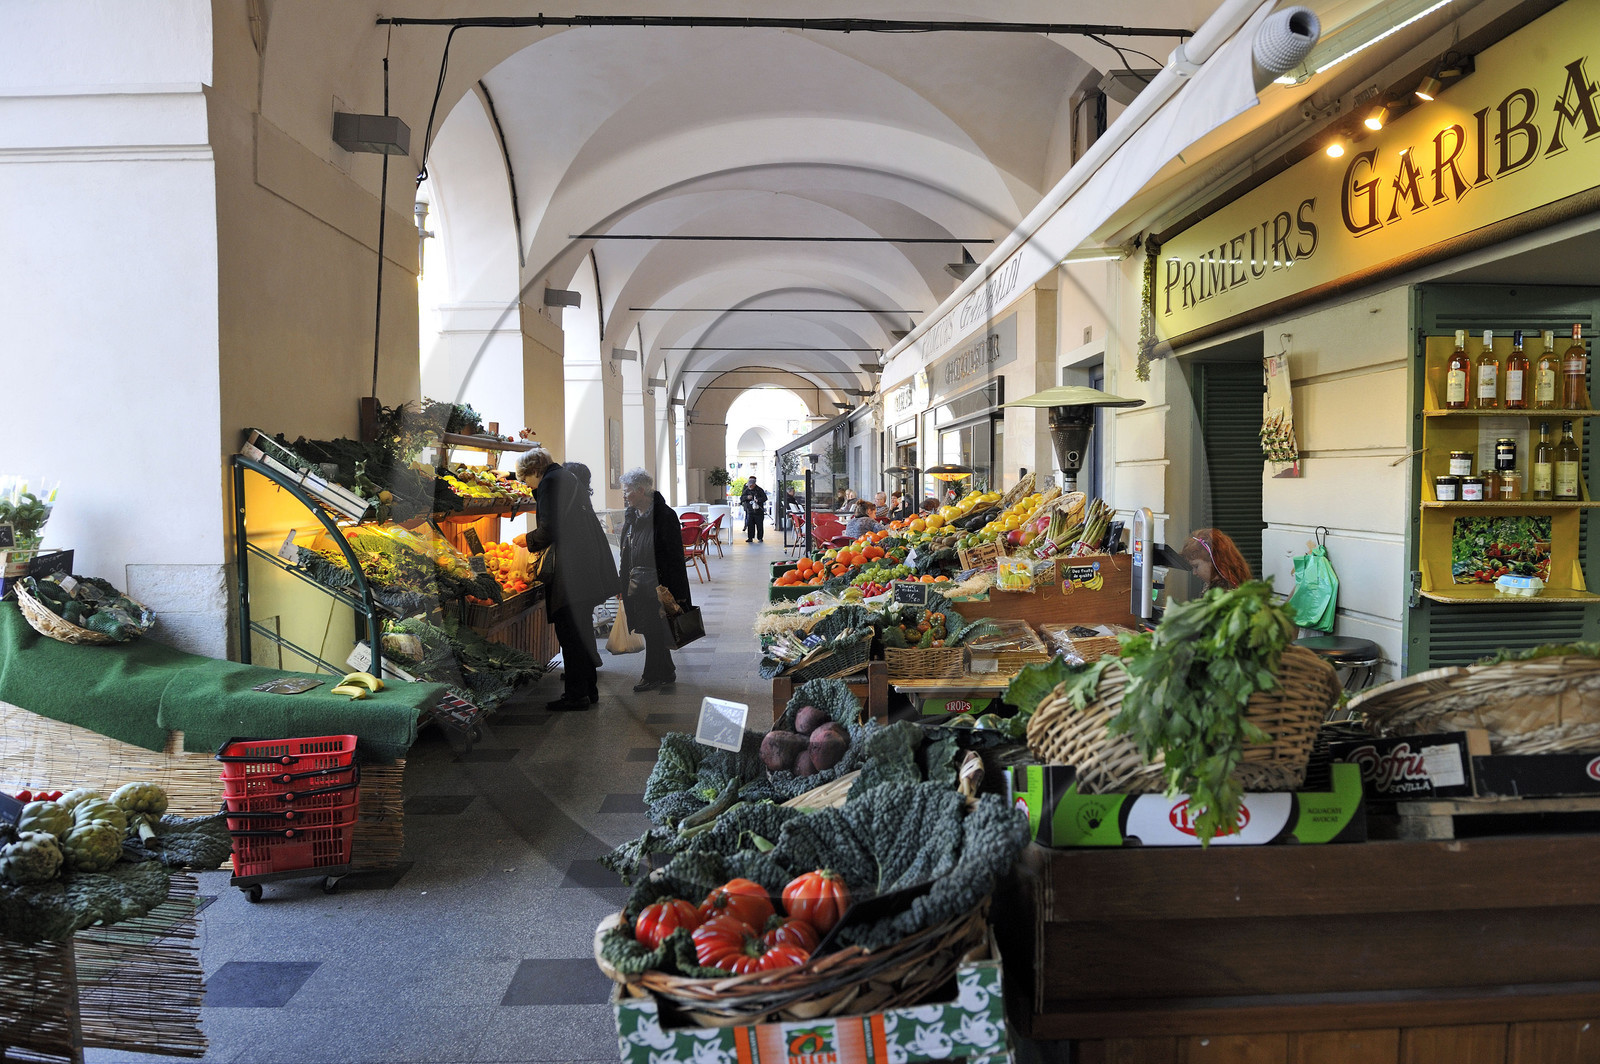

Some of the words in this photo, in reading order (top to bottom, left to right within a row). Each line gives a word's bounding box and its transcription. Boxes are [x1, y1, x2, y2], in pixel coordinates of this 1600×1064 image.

[1164, 197, 1319, 317] PRIMEURS
[946, 701, 971, 711] TROPS
[1390, 781, 1431, 793] SEVILLA
